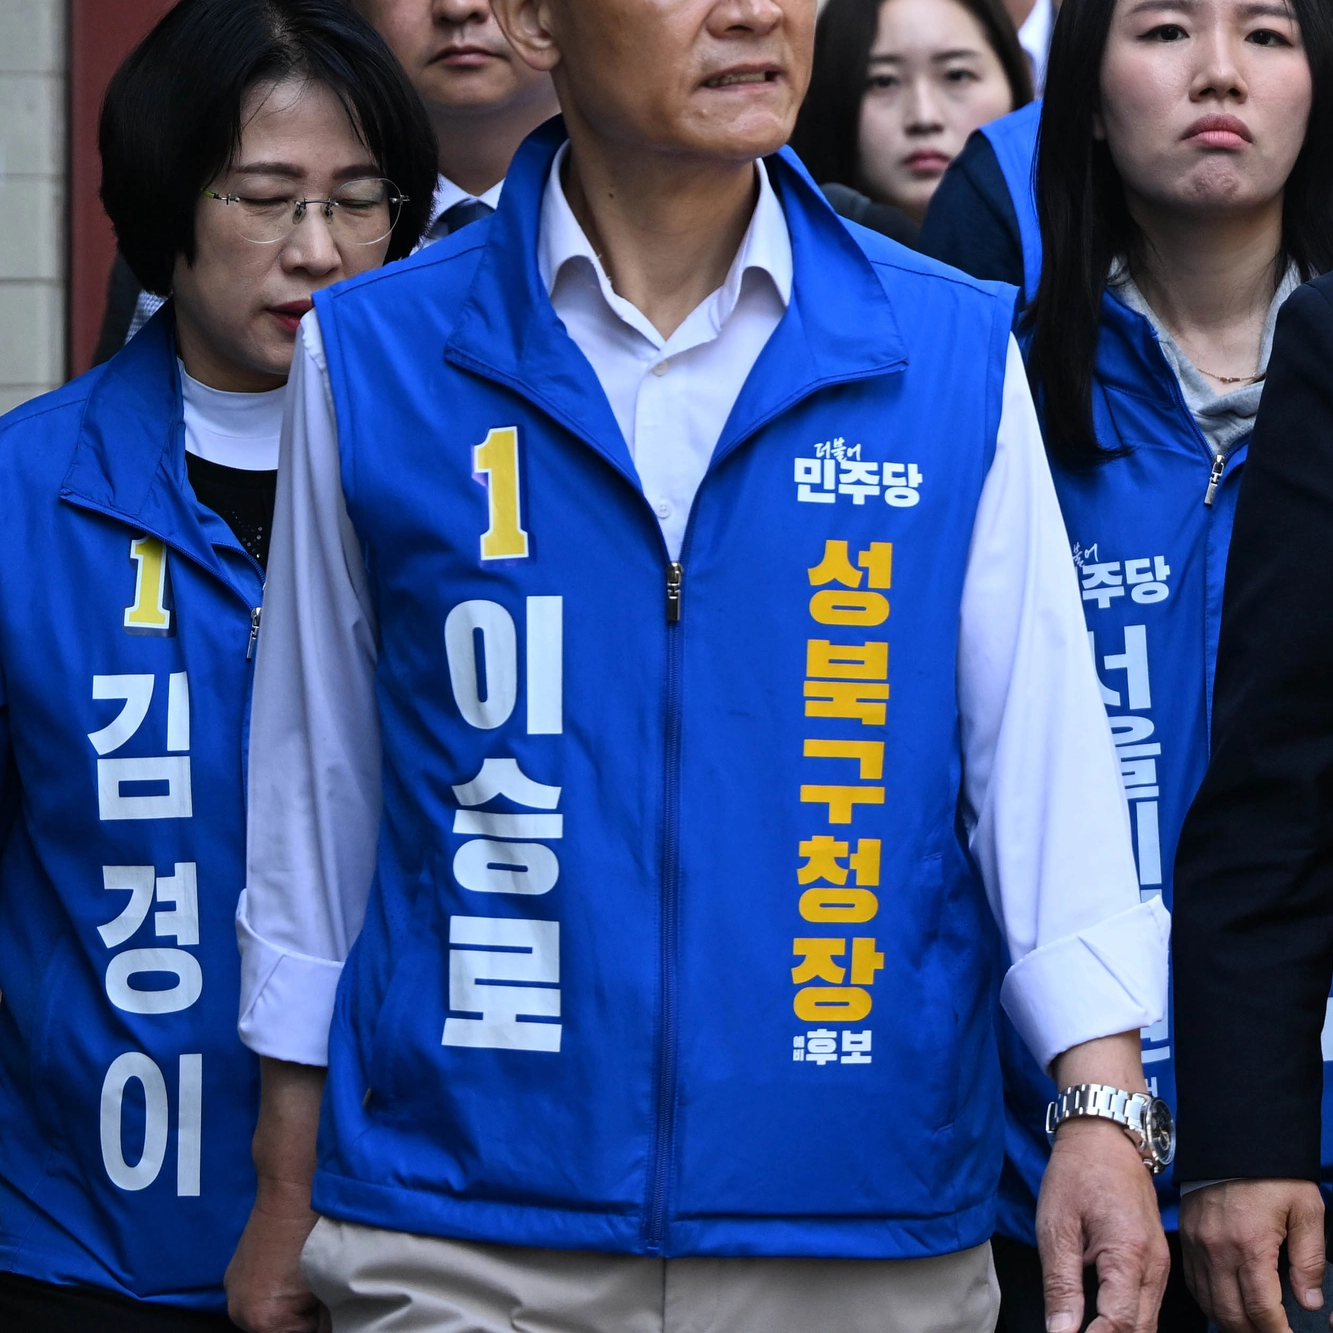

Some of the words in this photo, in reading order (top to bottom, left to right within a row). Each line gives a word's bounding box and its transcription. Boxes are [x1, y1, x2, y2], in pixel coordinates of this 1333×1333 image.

[470, 426, 530, 561] 1
[794, 457, 923, 507] 민주당
[814, 437, 861, 464] 더불어
[124, 534, 170, 629] 1
[1074, 555, 1171, 609] 주당
[441, 595, 564, 1053] 이승로
[792, 539, 893, 1021] 성북구청장
[87, 670, 203, 1197] 김경이
